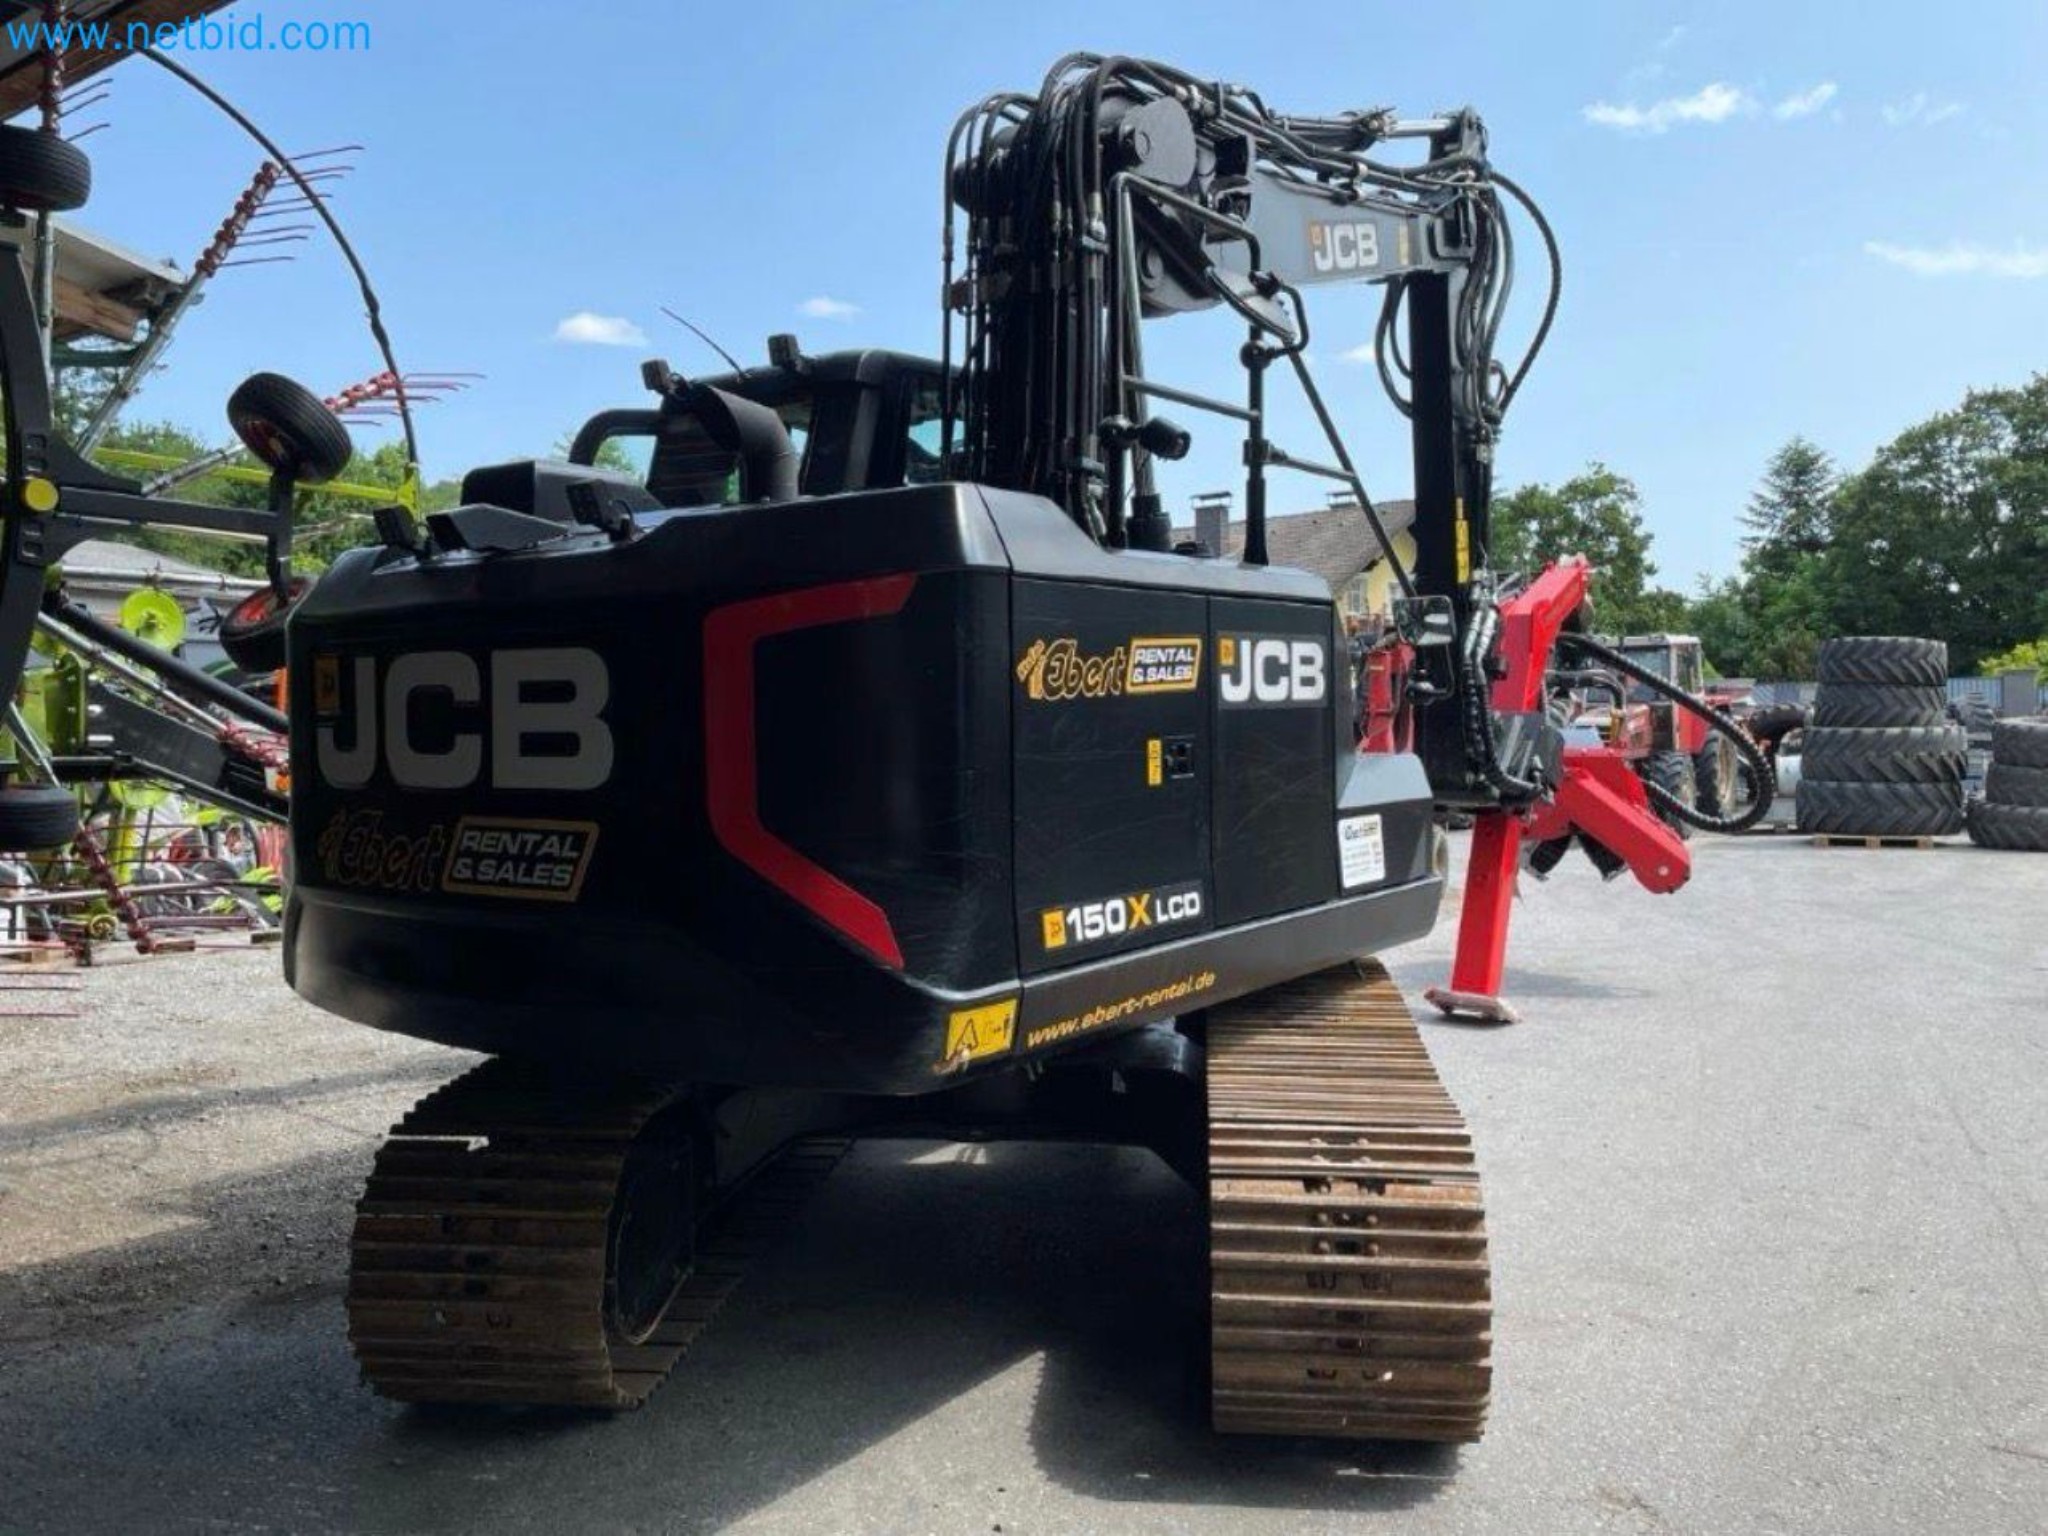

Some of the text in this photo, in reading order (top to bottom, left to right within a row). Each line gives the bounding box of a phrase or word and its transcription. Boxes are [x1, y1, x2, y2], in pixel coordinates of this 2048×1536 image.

[1313, 223, 1379, 271] JCB
[1042, 638, 1126, 700] Ebert
[1133, 647, 1194, 664] RENTAL
[1147, 665, 1193, 682] SALES
[1221, 639, 1325, 702] JCB
[317, 648, 614, 789] JCB
[460, 829, 582, 858] RENTAL
[452, 858, 573, 886] & SALES
[1156, 891, 1200, 923] LCD
[1026, 971, 1216, 1047] www.ebert-rental.de
